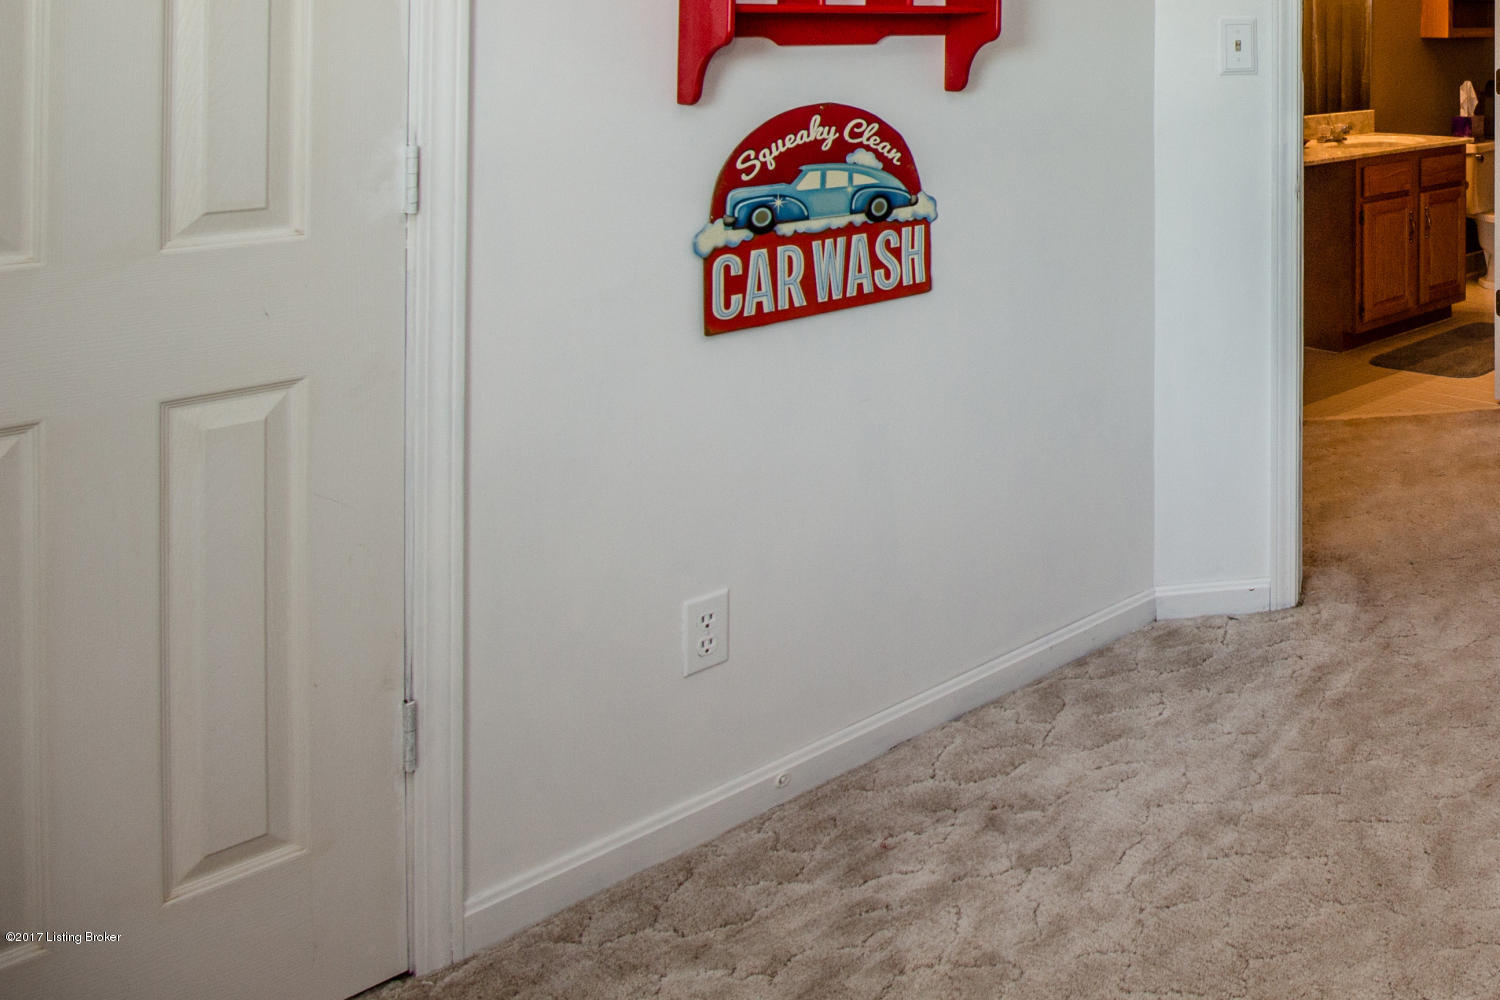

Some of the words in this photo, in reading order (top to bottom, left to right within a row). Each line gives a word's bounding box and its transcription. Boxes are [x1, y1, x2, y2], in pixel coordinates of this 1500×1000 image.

[736, 114, 839, 181] Squeaky
[844, 118, 901, 165] Clean
[712, 245, 806, 320] CAR
[812, 224, 926, 303] WASH
